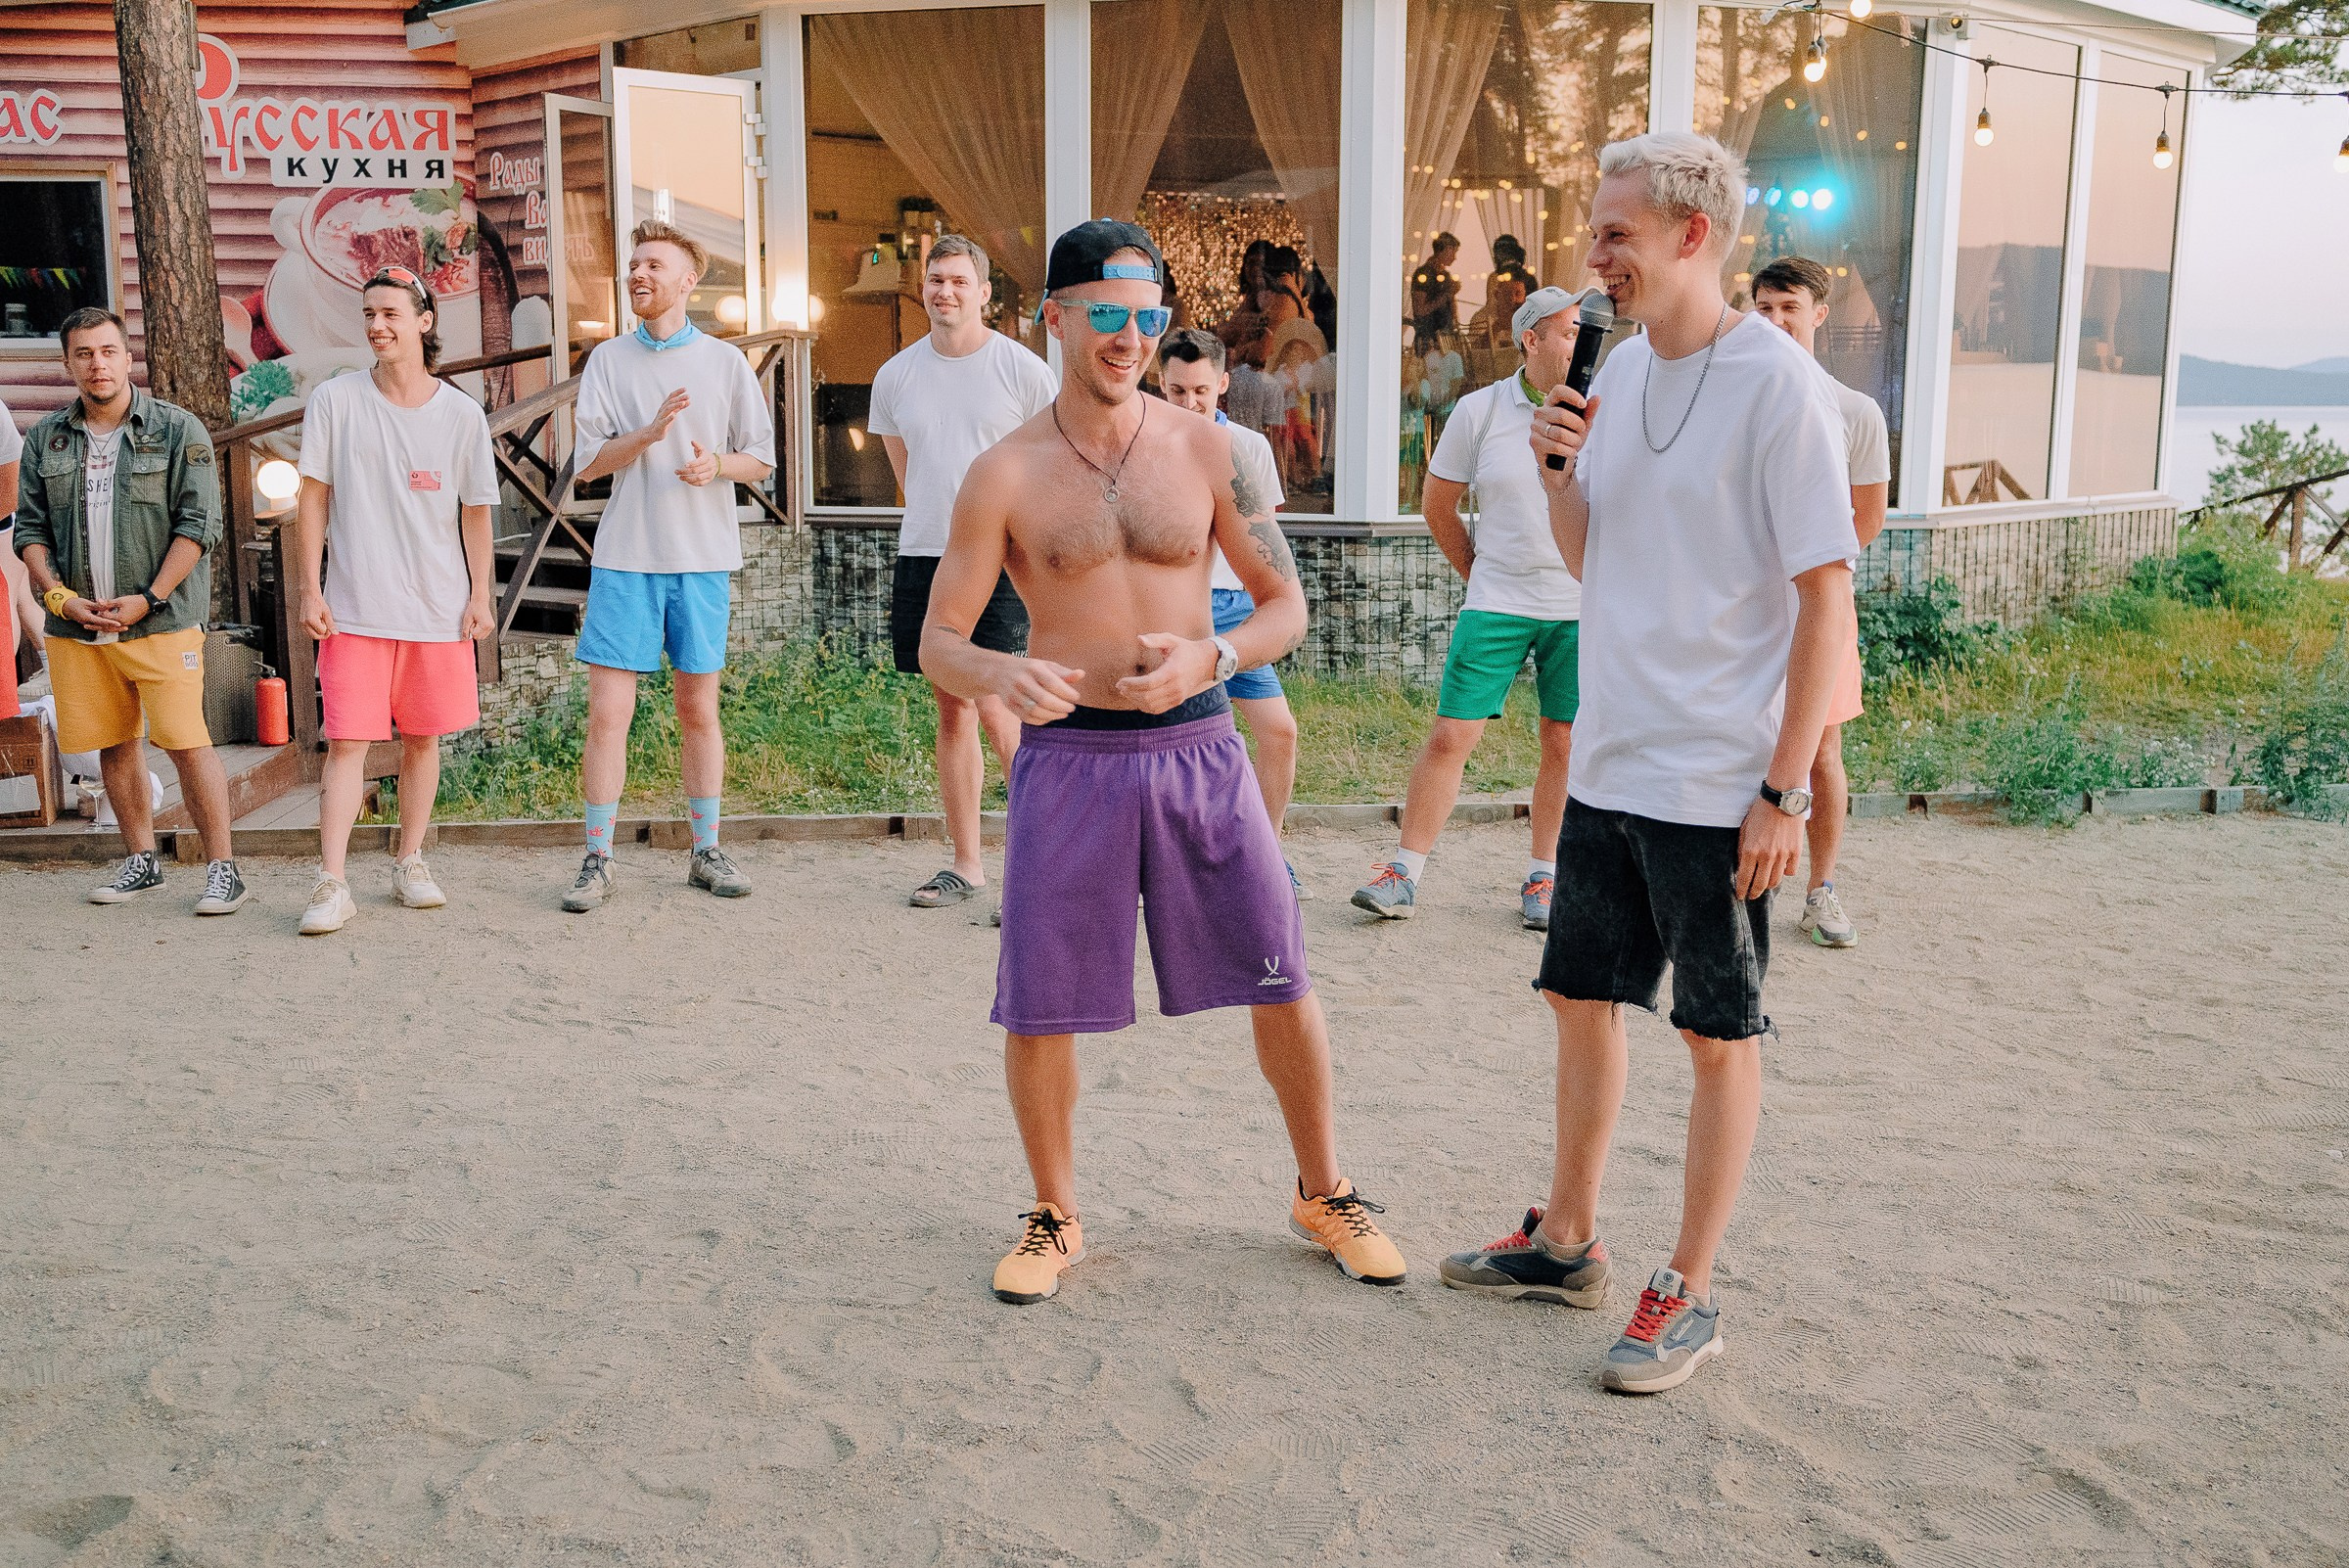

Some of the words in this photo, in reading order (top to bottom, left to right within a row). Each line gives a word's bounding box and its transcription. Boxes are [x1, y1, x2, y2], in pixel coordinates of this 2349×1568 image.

[287, 157, 445, 184] кухня
[491, 155, 539, 190] Рады
[1257, 977, 1292, 986] JÖGEL
